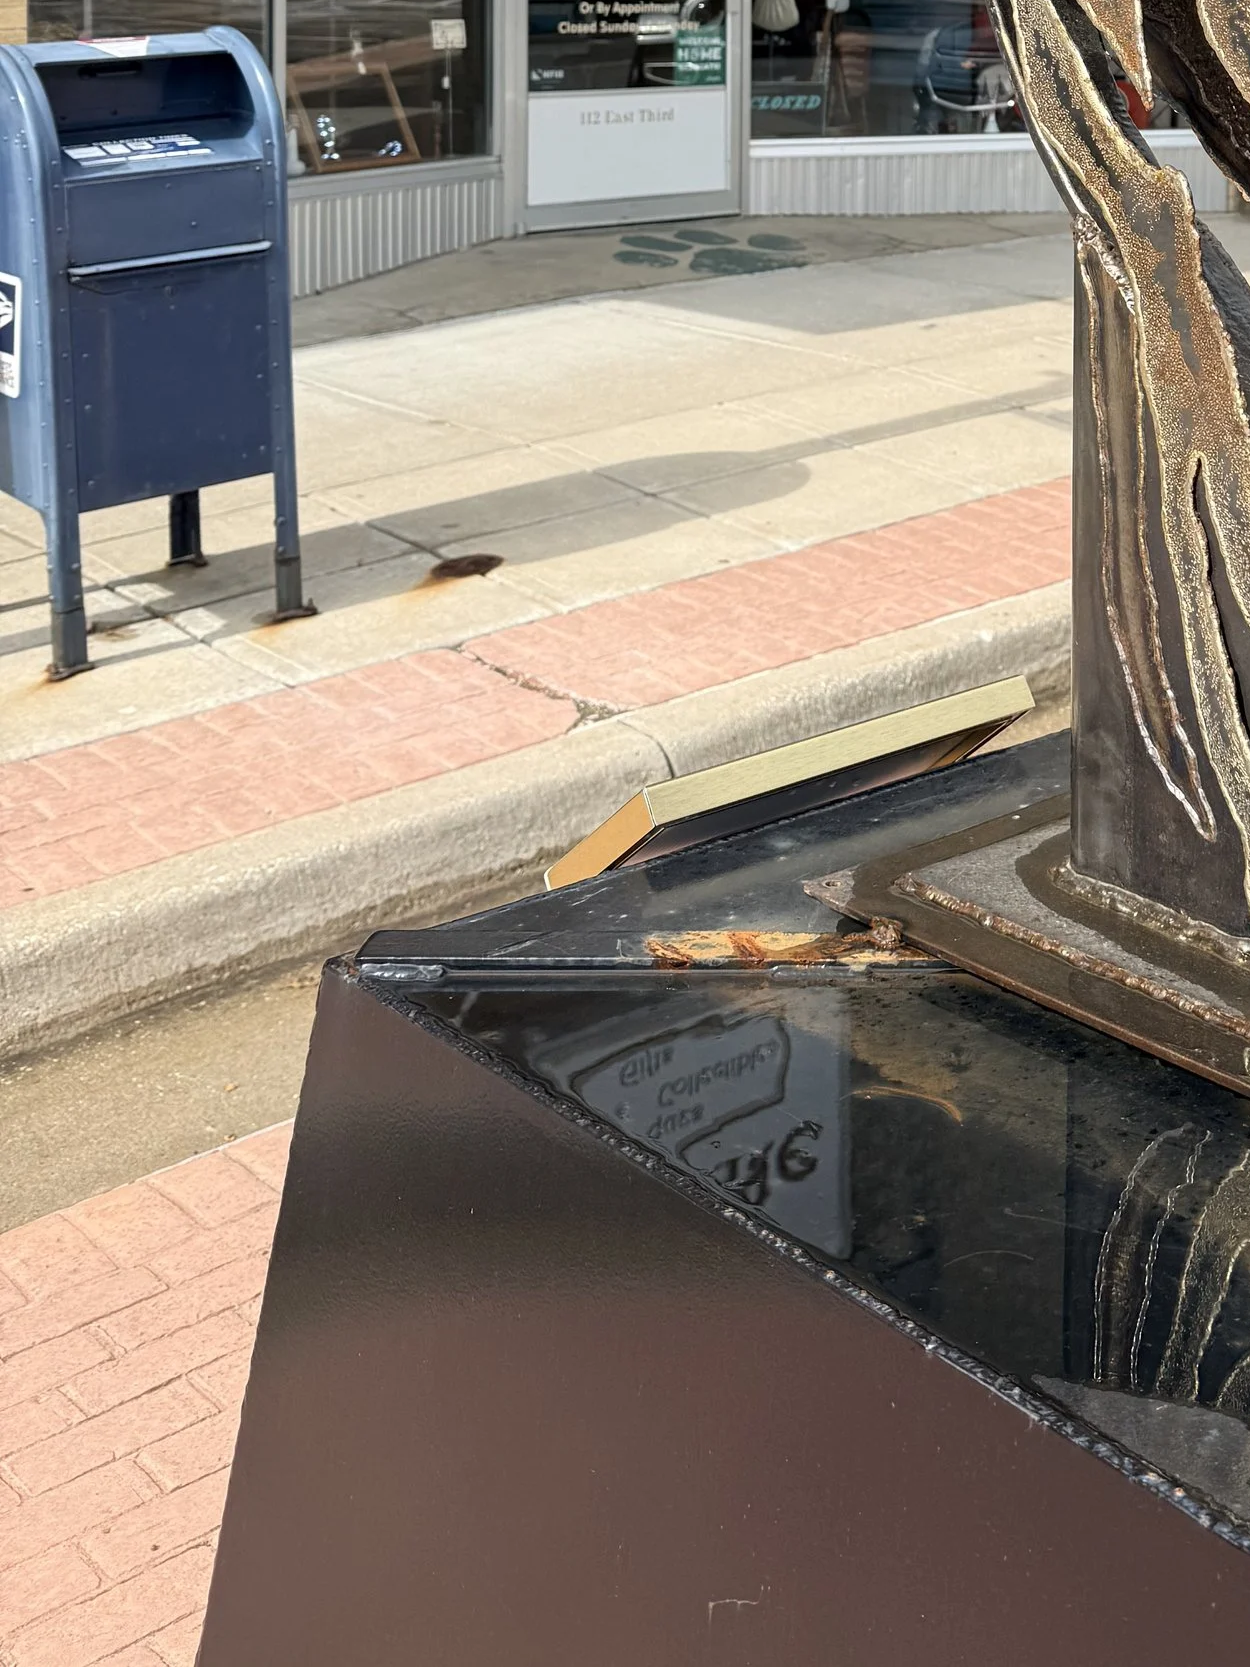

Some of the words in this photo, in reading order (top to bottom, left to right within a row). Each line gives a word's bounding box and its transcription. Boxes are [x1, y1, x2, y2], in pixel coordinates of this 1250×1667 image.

[579, 1, 595, 14] Or
[595, 1, 611, 16] By
[557, 21, 597, 34] Closed
[580, 110, 600, 126] 112
[639, 107, 674, 123] Third
